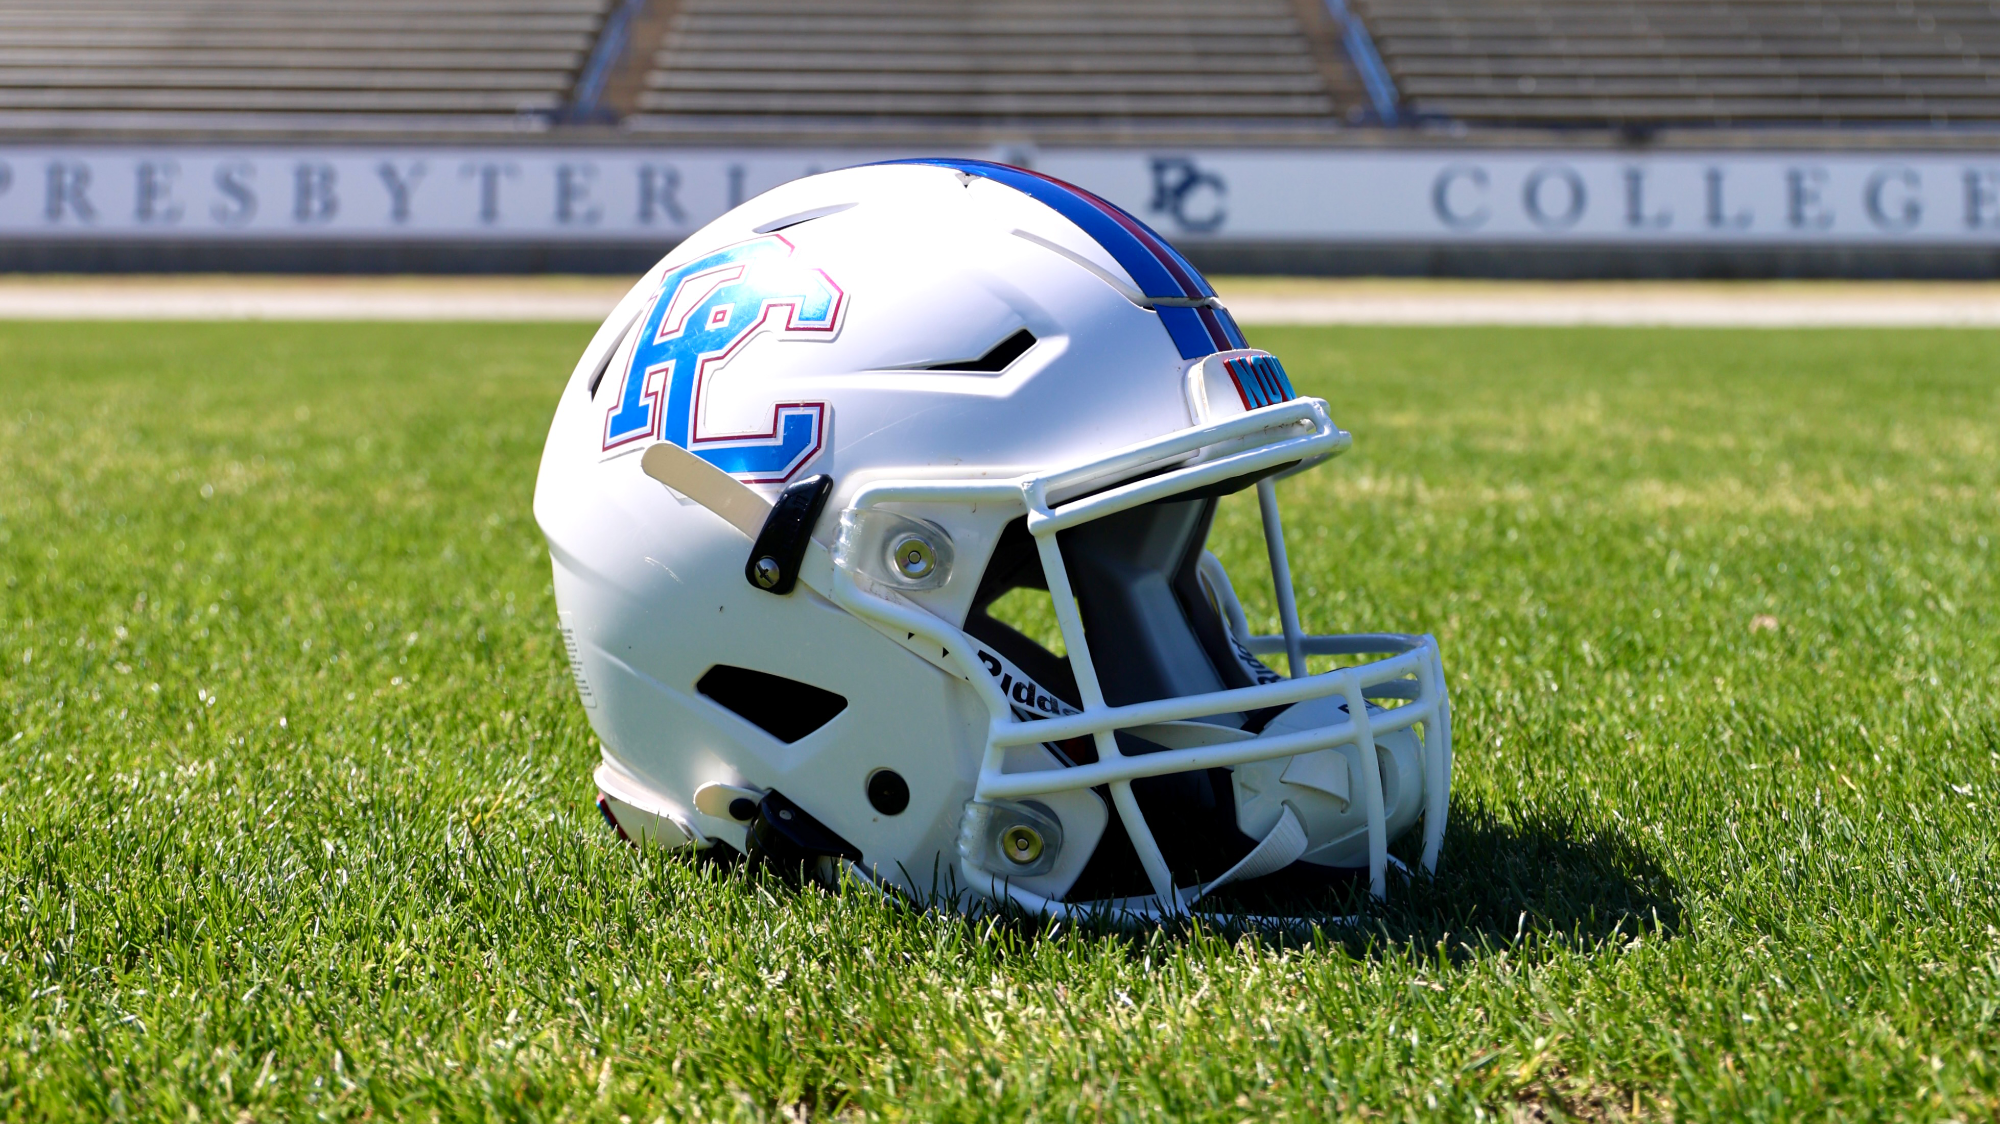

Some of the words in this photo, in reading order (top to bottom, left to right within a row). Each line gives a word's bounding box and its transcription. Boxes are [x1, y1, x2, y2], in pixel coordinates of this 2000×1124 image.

[0, 161, 820, 224] RESBYTERI
[1147, 155, 1229, 233] PC
[1431, 162, 2000, 232] COLLEGE
